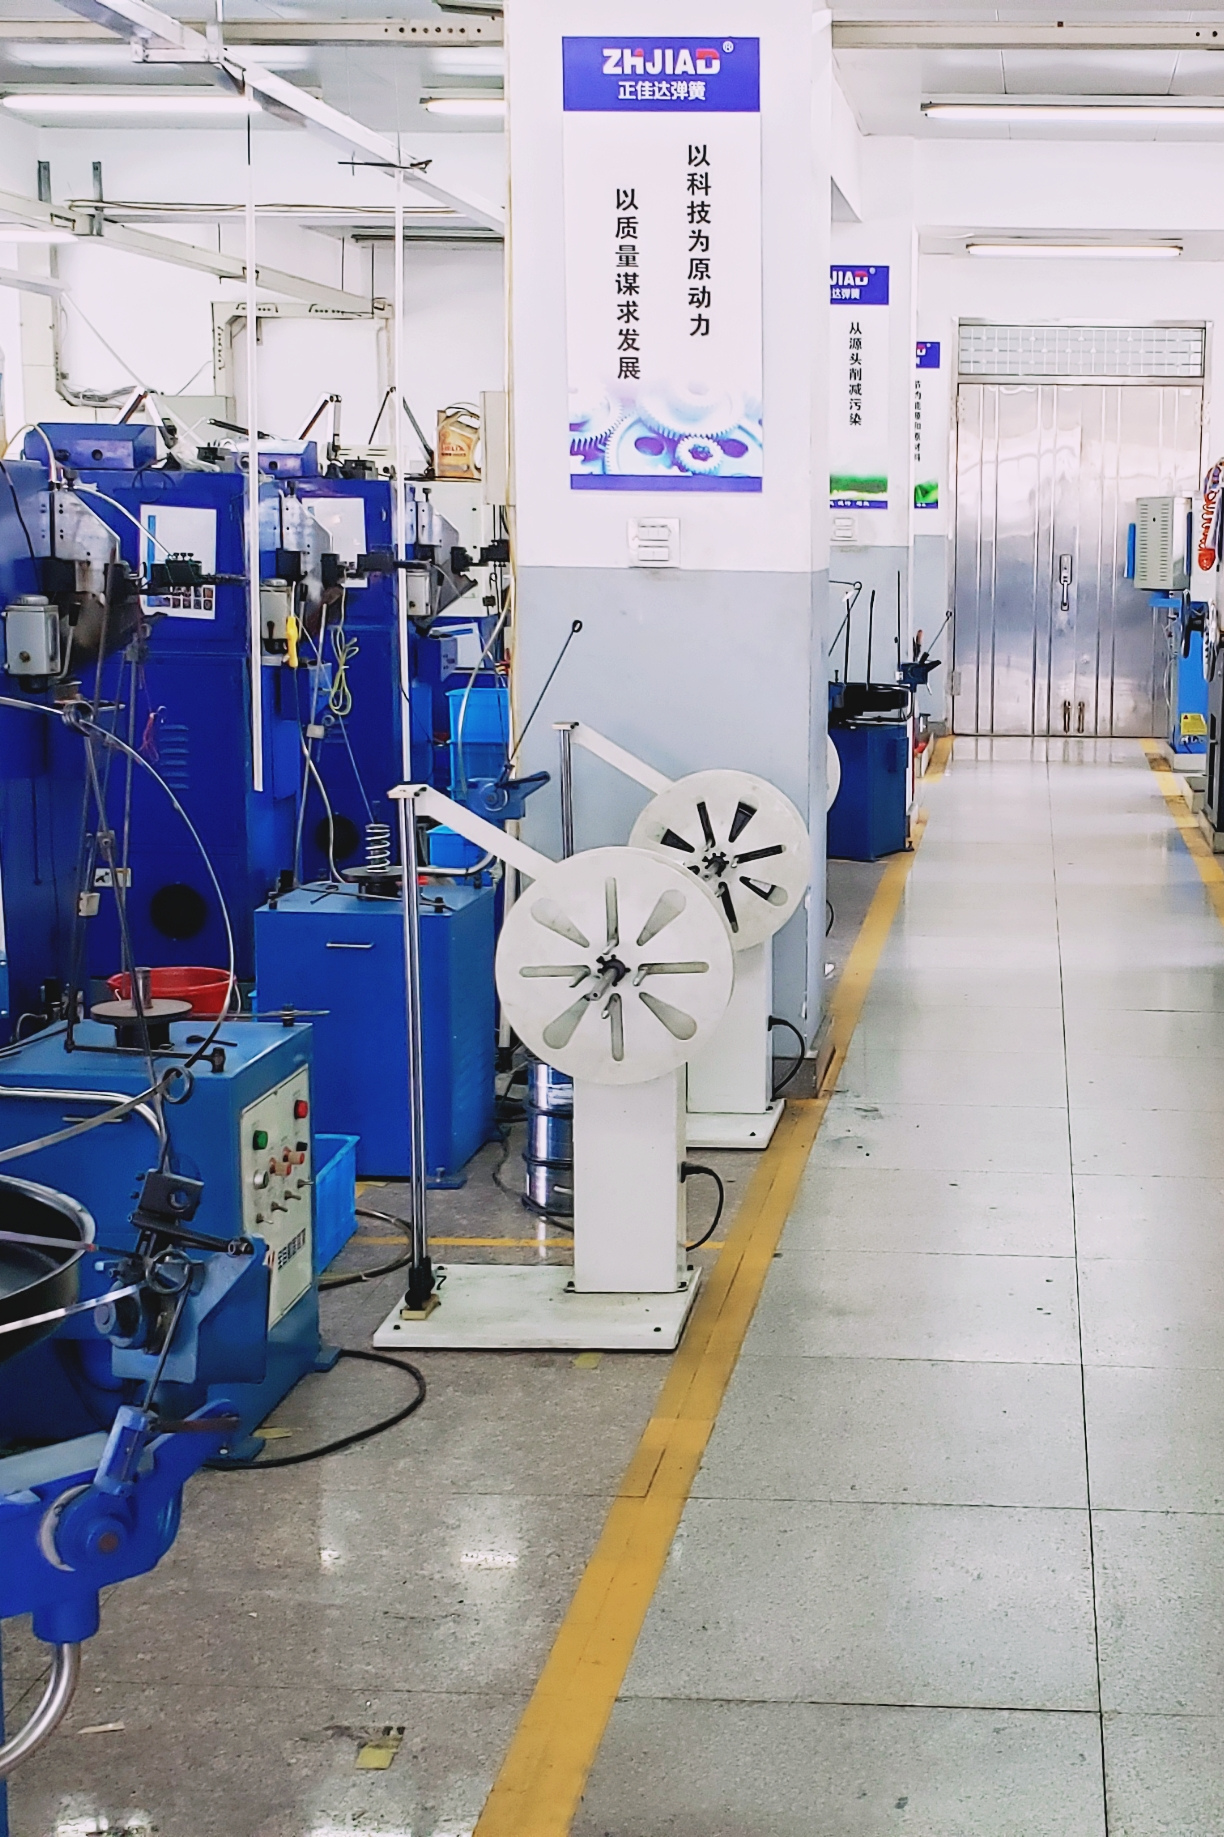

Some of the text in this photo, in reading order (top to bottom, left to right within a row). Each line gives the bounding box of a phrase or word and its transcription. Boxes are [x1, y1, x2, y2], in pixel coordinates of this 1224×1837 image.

[618, 81, 706, 101] 正佳达弹簧
[615, 187, 641, 381] 以质量谋求发展
[687, 144, 711, 337] 以科技为原动力
[849, 321, 862, 426] 从源头削减污染
